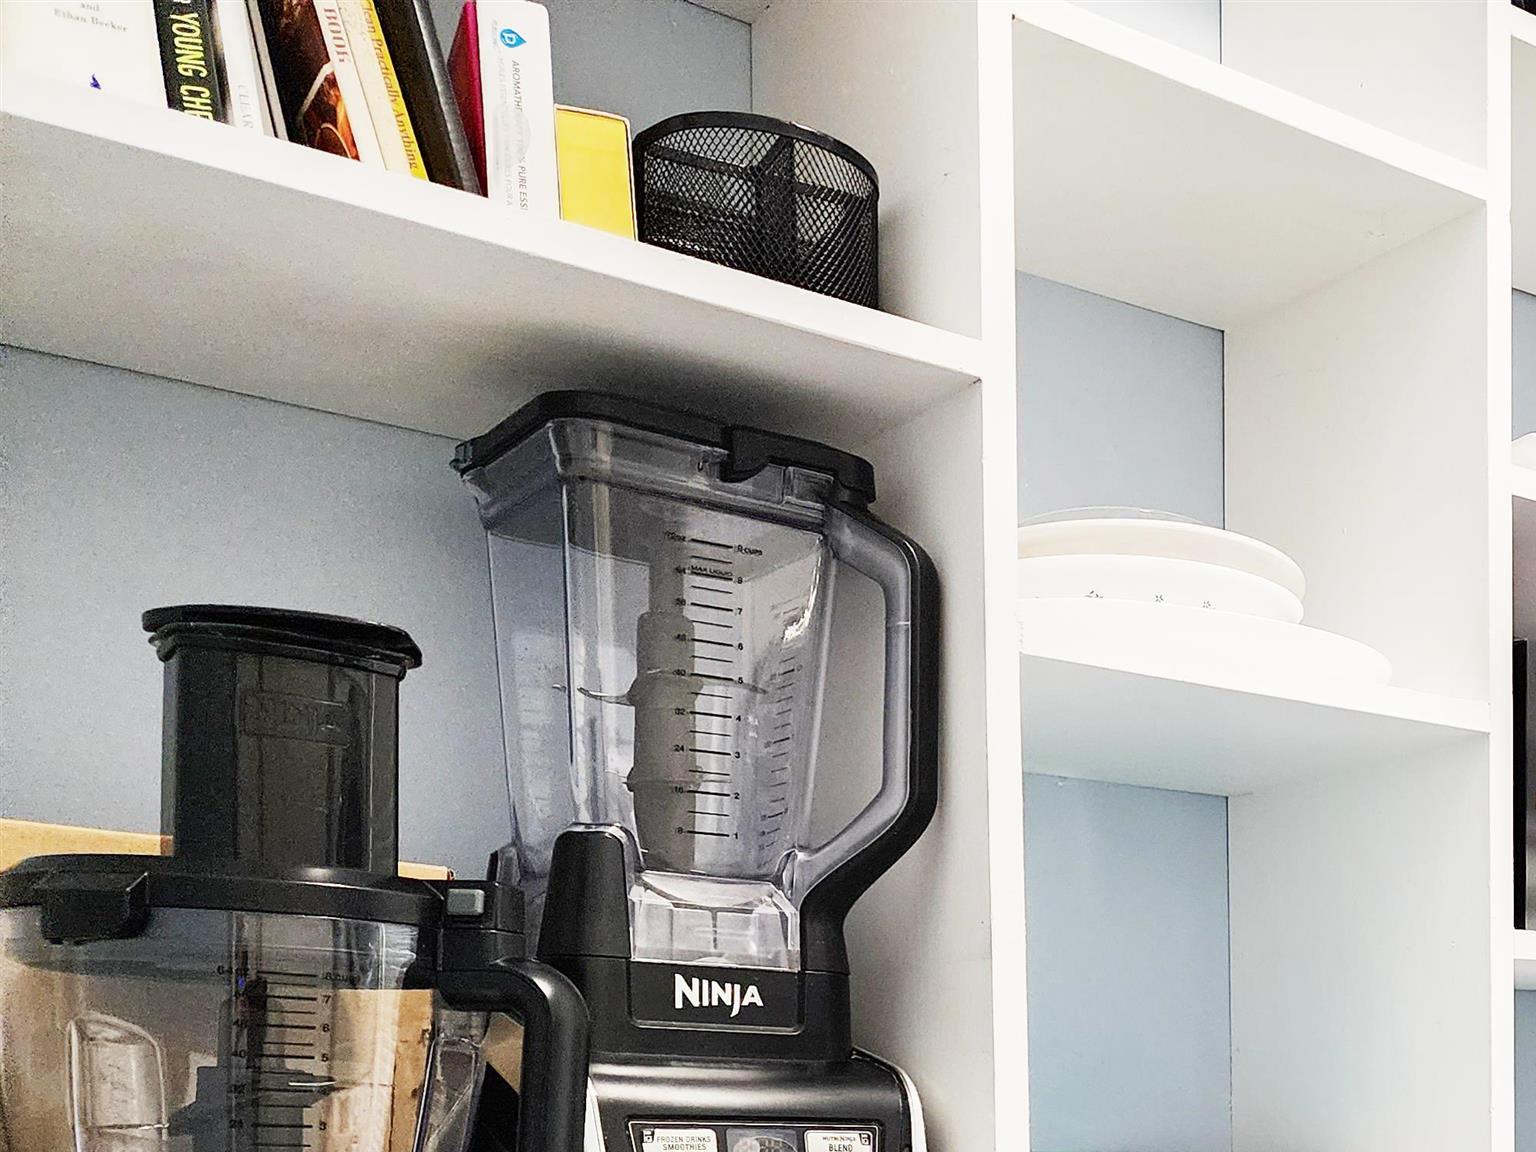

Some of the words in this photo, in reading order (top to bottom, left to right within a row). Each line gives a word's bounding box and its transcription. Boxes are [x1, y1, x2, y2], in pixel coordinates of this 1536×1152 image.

[170, 13, 208, 78] YOUNG
[371, 38, 400, 105] Practically
[393, 110, 419, 170] Anything
[517, 165, 529, 194] PURE
[734, 751, 741, 759] 3
[734, 792, 740, 800] 2
[322, 994, 332, 1005] 7
[674, 973, 764, 1018] NINJA
[322, 1023, 331, 1033] 6
[321, 1052, 329, 1062] 5
[656, 1135, 684, 1143] FROZEN
[662, 1143, 707, 1151] SMOOTHIES
[828, 1143, 853, 1152] BLEND
